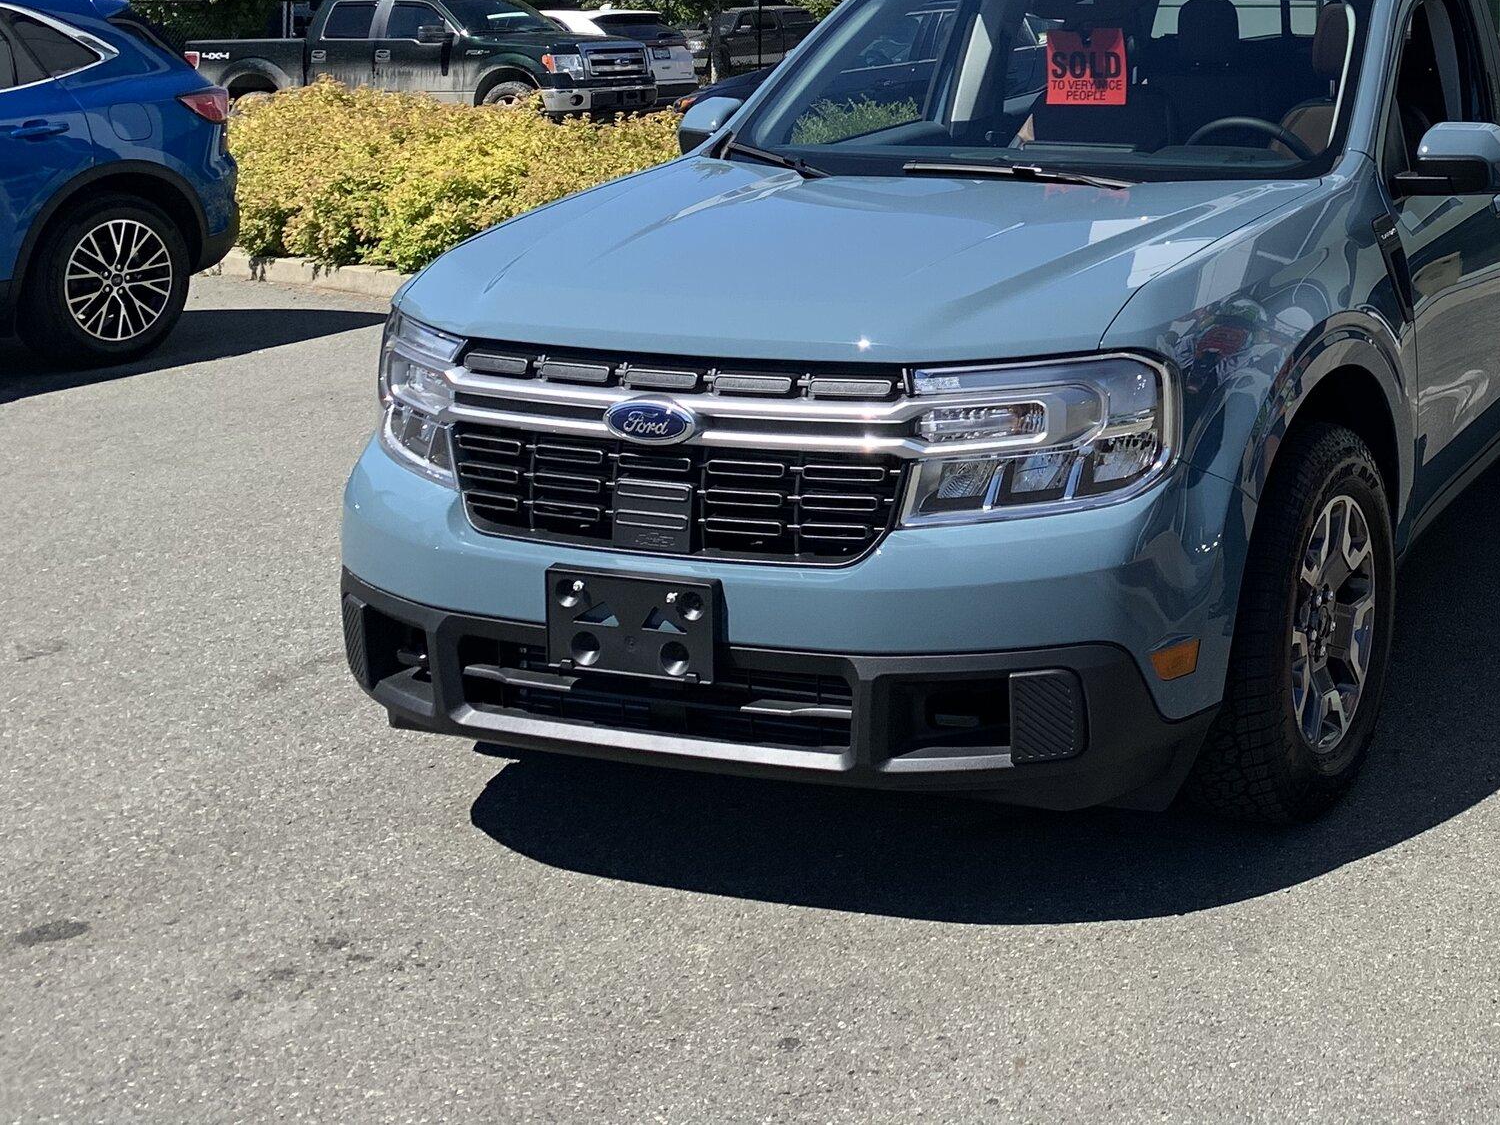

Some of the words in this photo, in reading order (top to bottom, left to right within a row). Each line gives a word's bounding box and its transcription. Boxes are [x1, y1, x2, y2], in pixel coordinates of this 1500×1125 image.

[1051, 51, 1122, 79] SOLD
[1051, 79, 1065, 90] TO
[1068, 79, 1093, 90] VERY
[1066, 90, 1106, 100] PEOPLE
[623, 410, 669, 436] Ford
